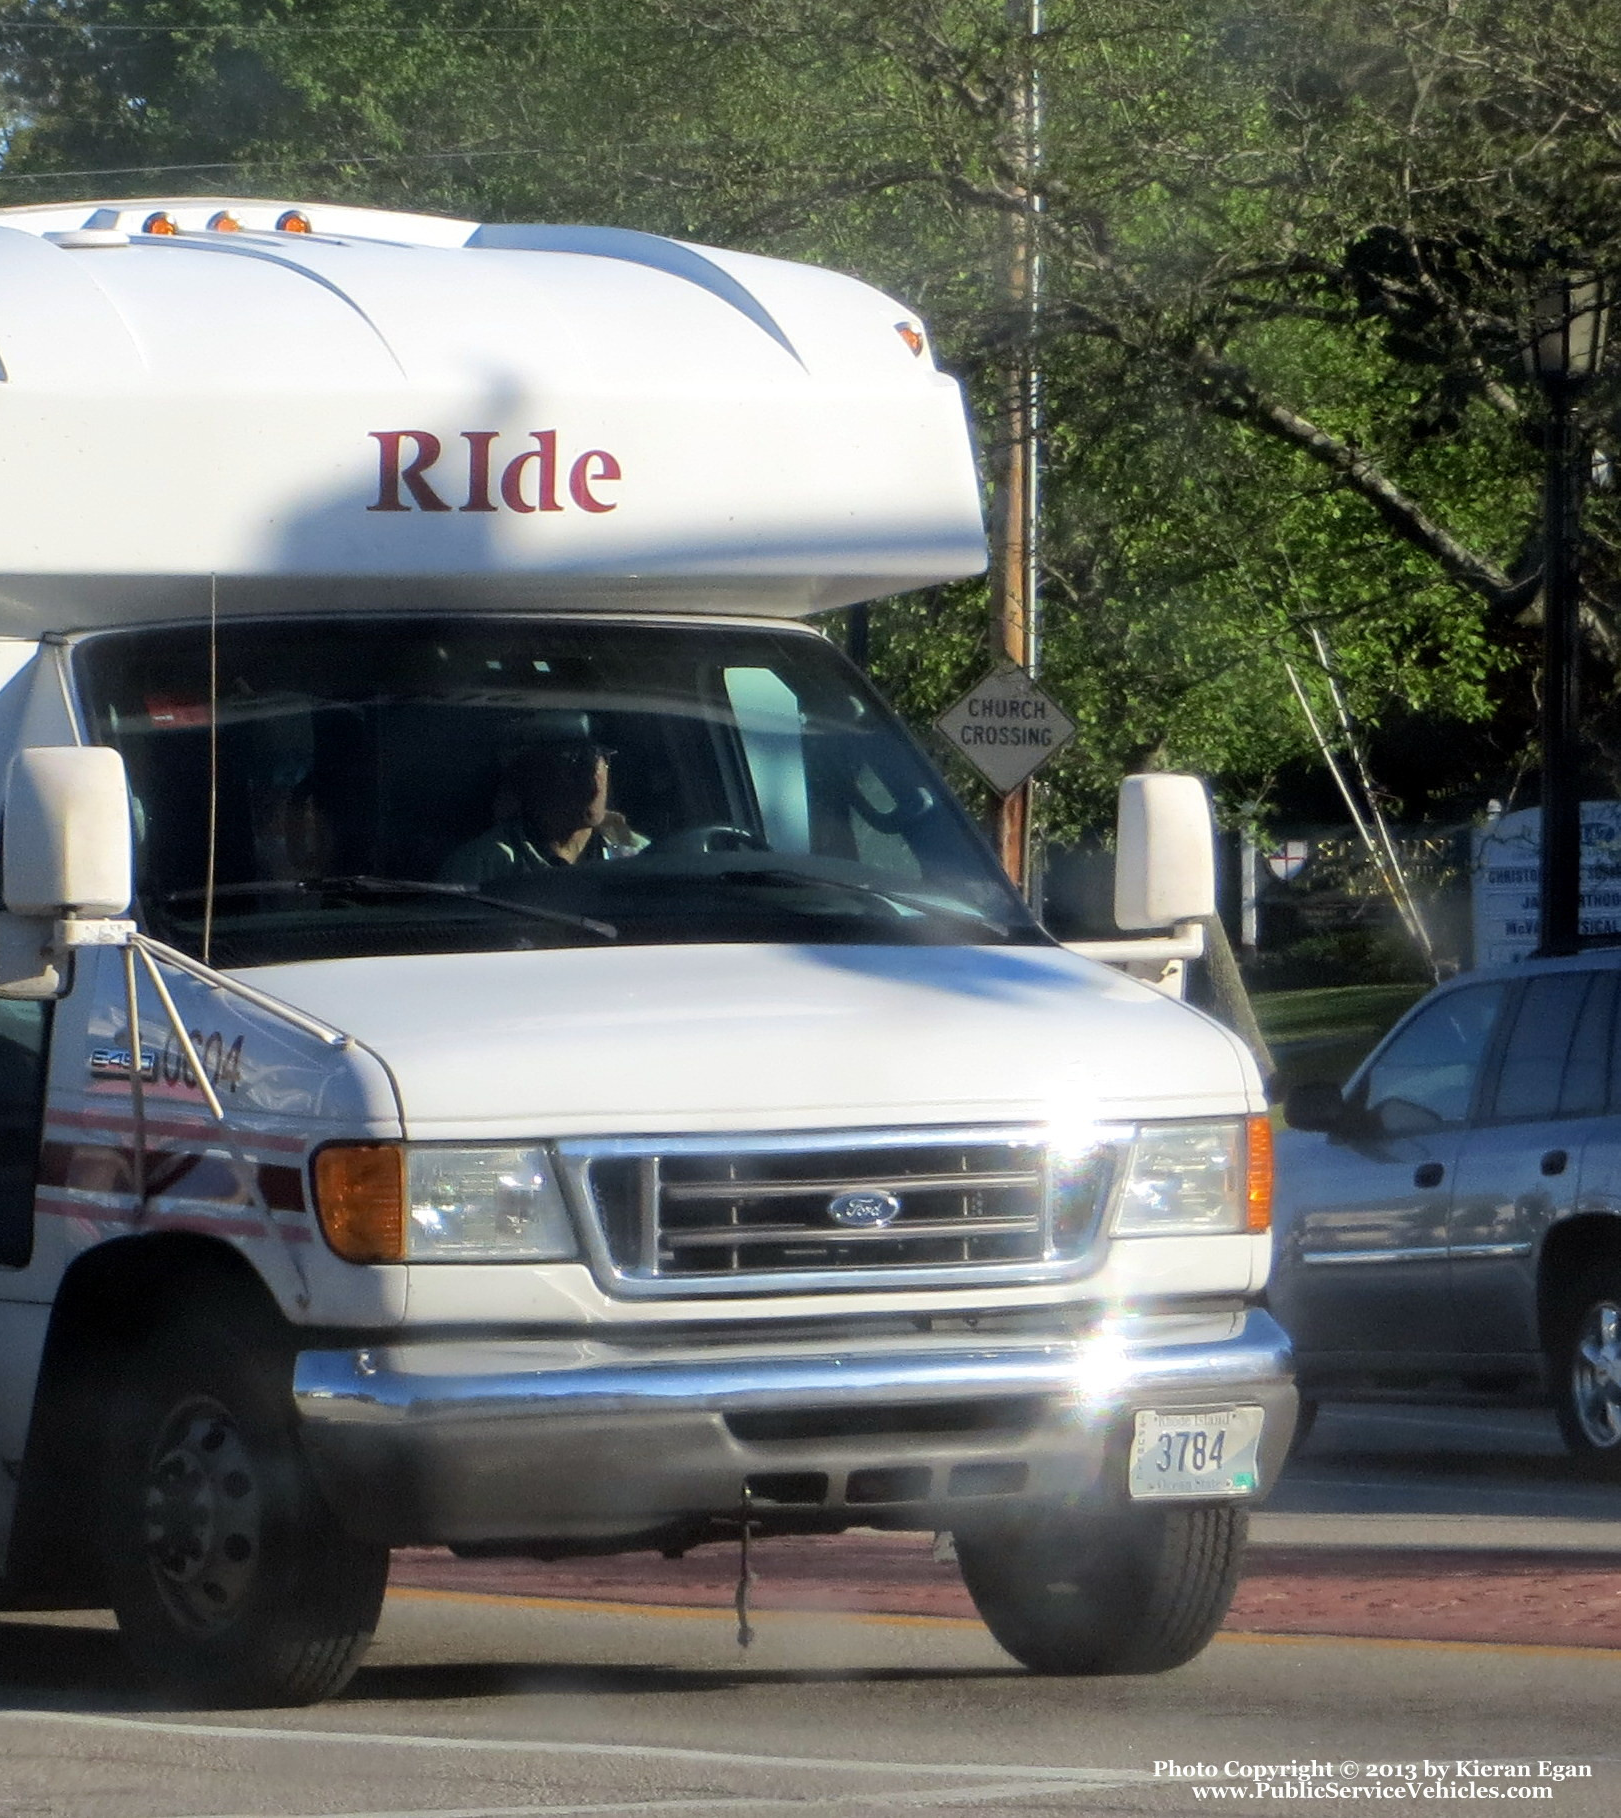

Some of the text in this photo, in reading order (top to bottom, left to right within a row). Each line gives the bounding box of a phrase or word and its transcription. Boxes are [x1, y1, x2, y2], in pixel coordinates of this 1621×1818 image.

[366, 430, 622, 513] RIde
[968, 698, 1046, 719] CHURCH
[961, 725, 1053, 746] CROSSING
[163, 1028, 245, 1093] 0604
[846, 1199, 883, 1218] Ford
[1195, 1412, 1230, 1426] Island
[1156, 1429, 1226, 1472] 3784
